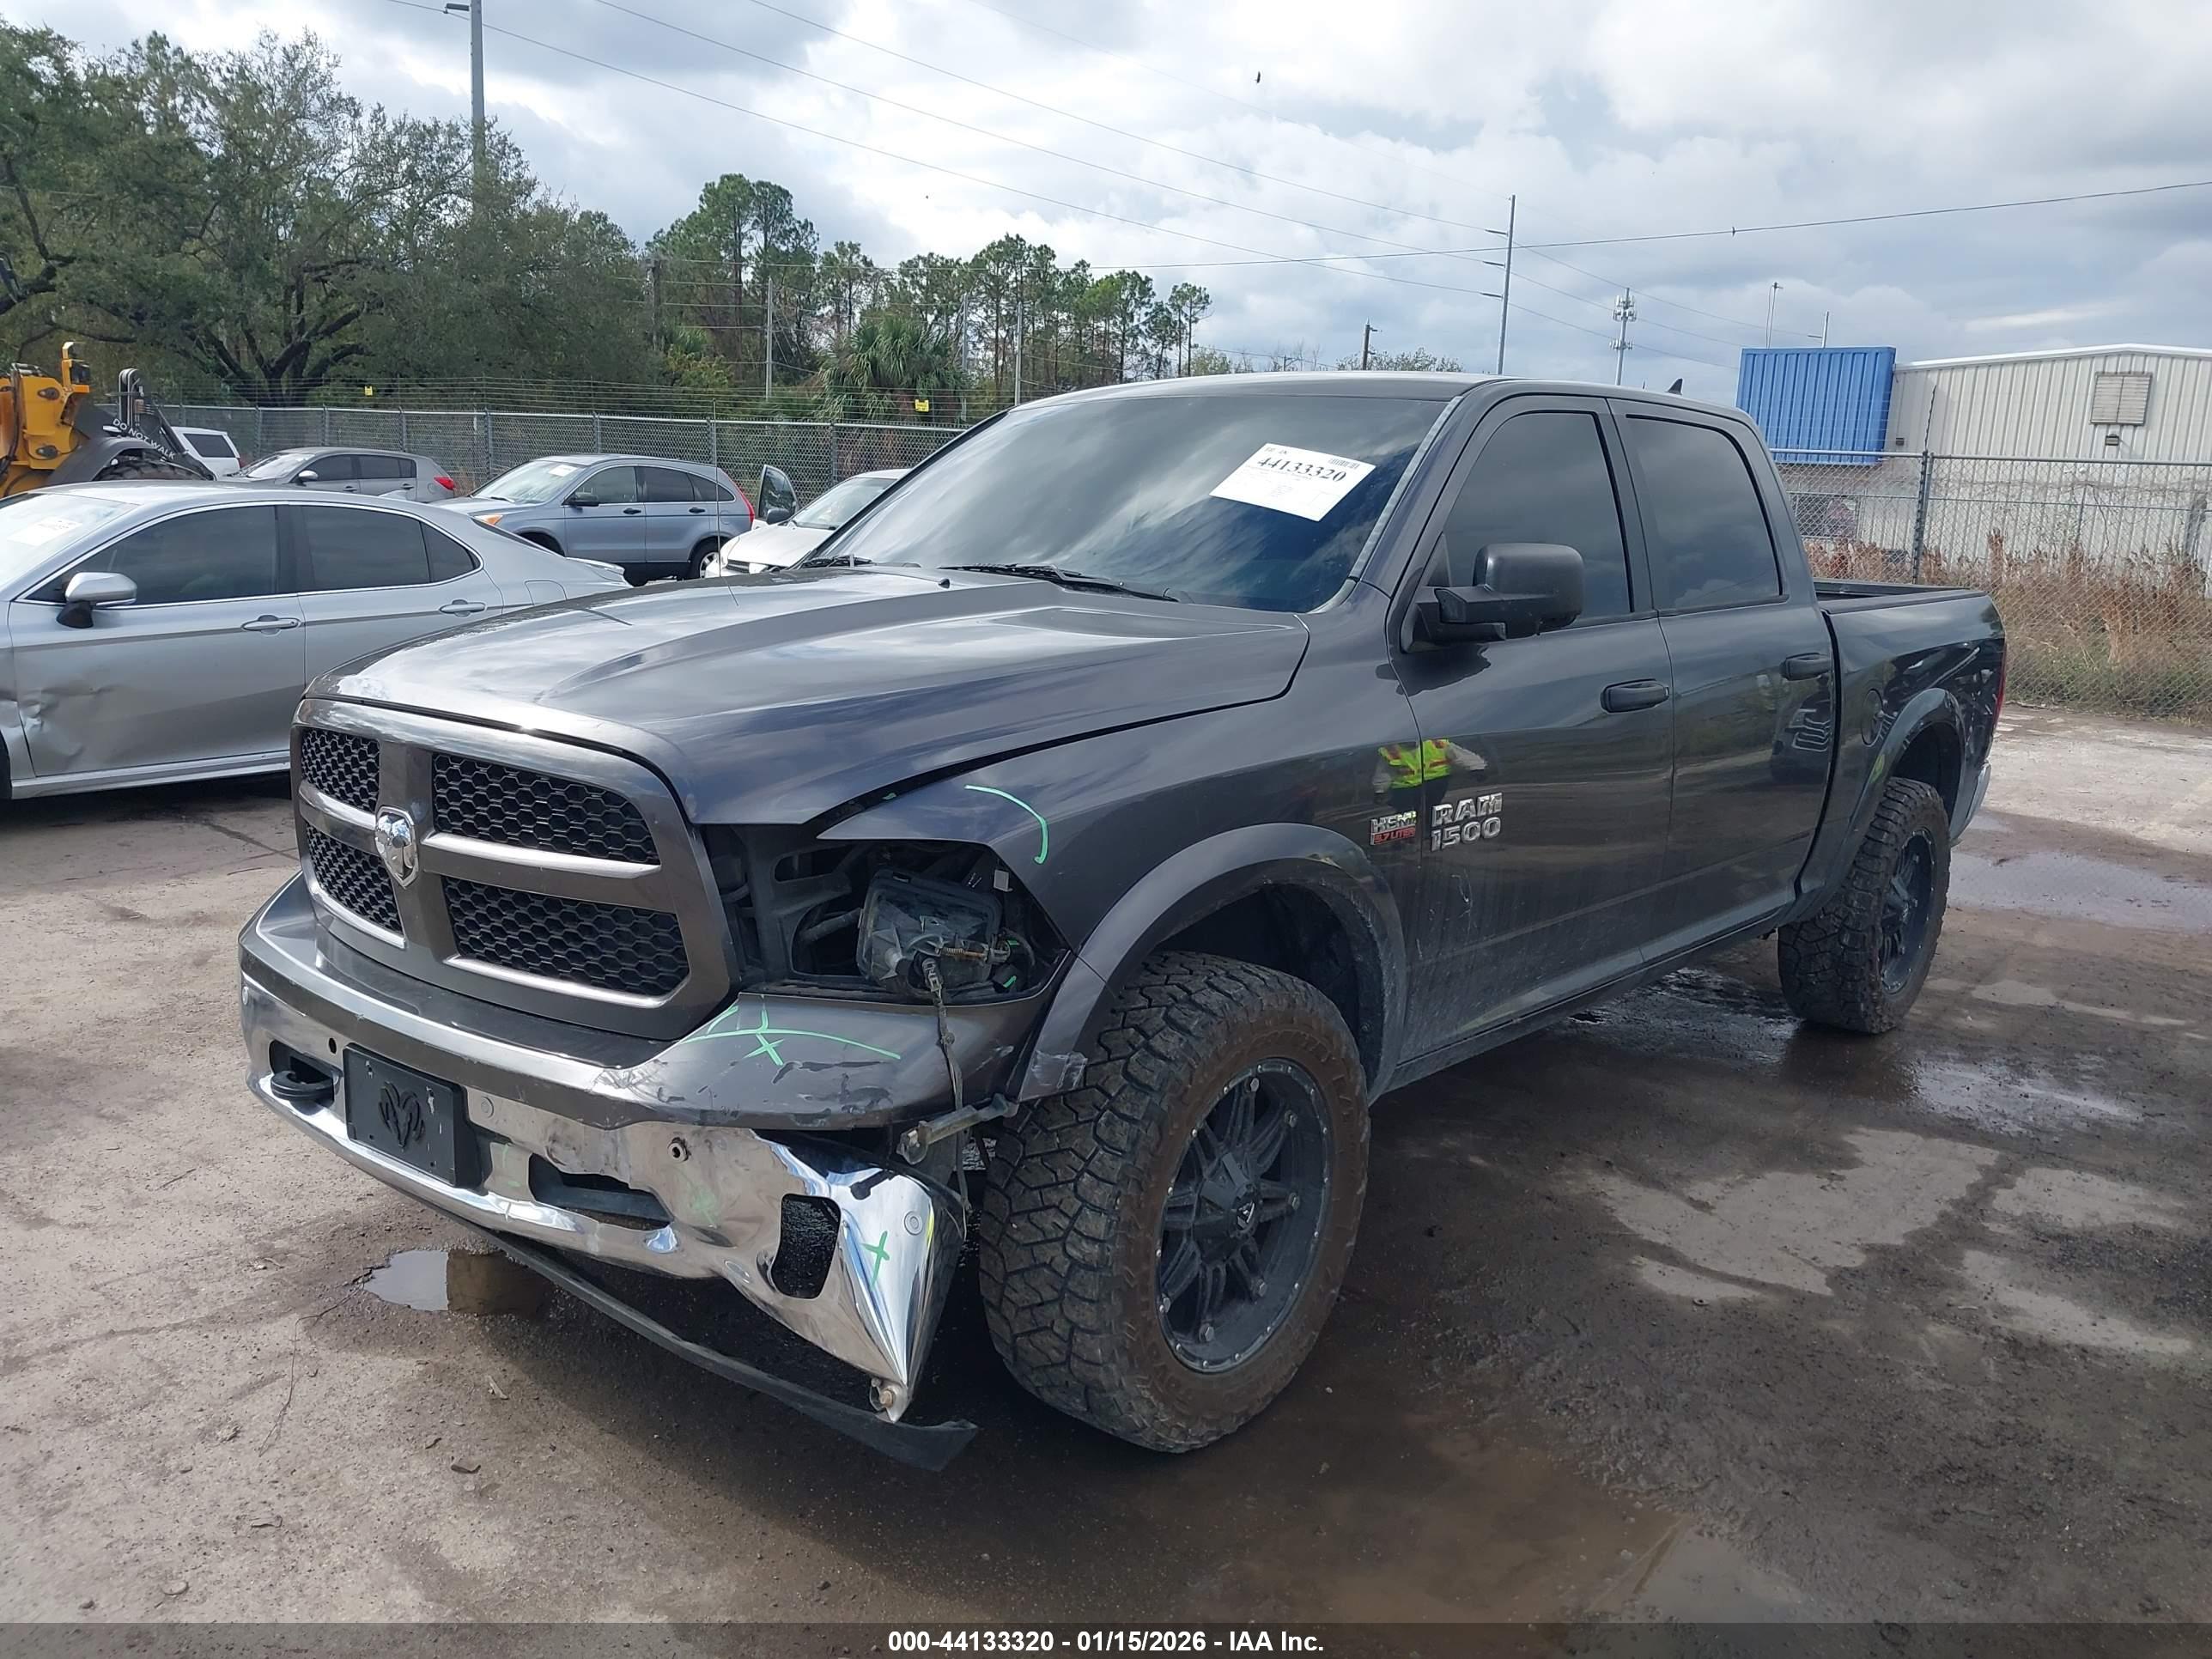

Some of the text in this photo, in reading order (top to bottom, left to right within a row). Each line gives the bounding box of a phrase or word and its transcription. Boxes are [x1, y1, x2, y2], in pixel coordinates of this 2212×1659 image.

[112, 418, 175, 459] DO NOT WALK
[1257, 457, 1346, 483] 44133320
[1372, 811, 1417, 834] HEMI
[1432, 793, 1503, 827] RAM
[1374, 827, 1416, 843] 5.7 LITER
[1431, 817, 1501, 852] 1500
